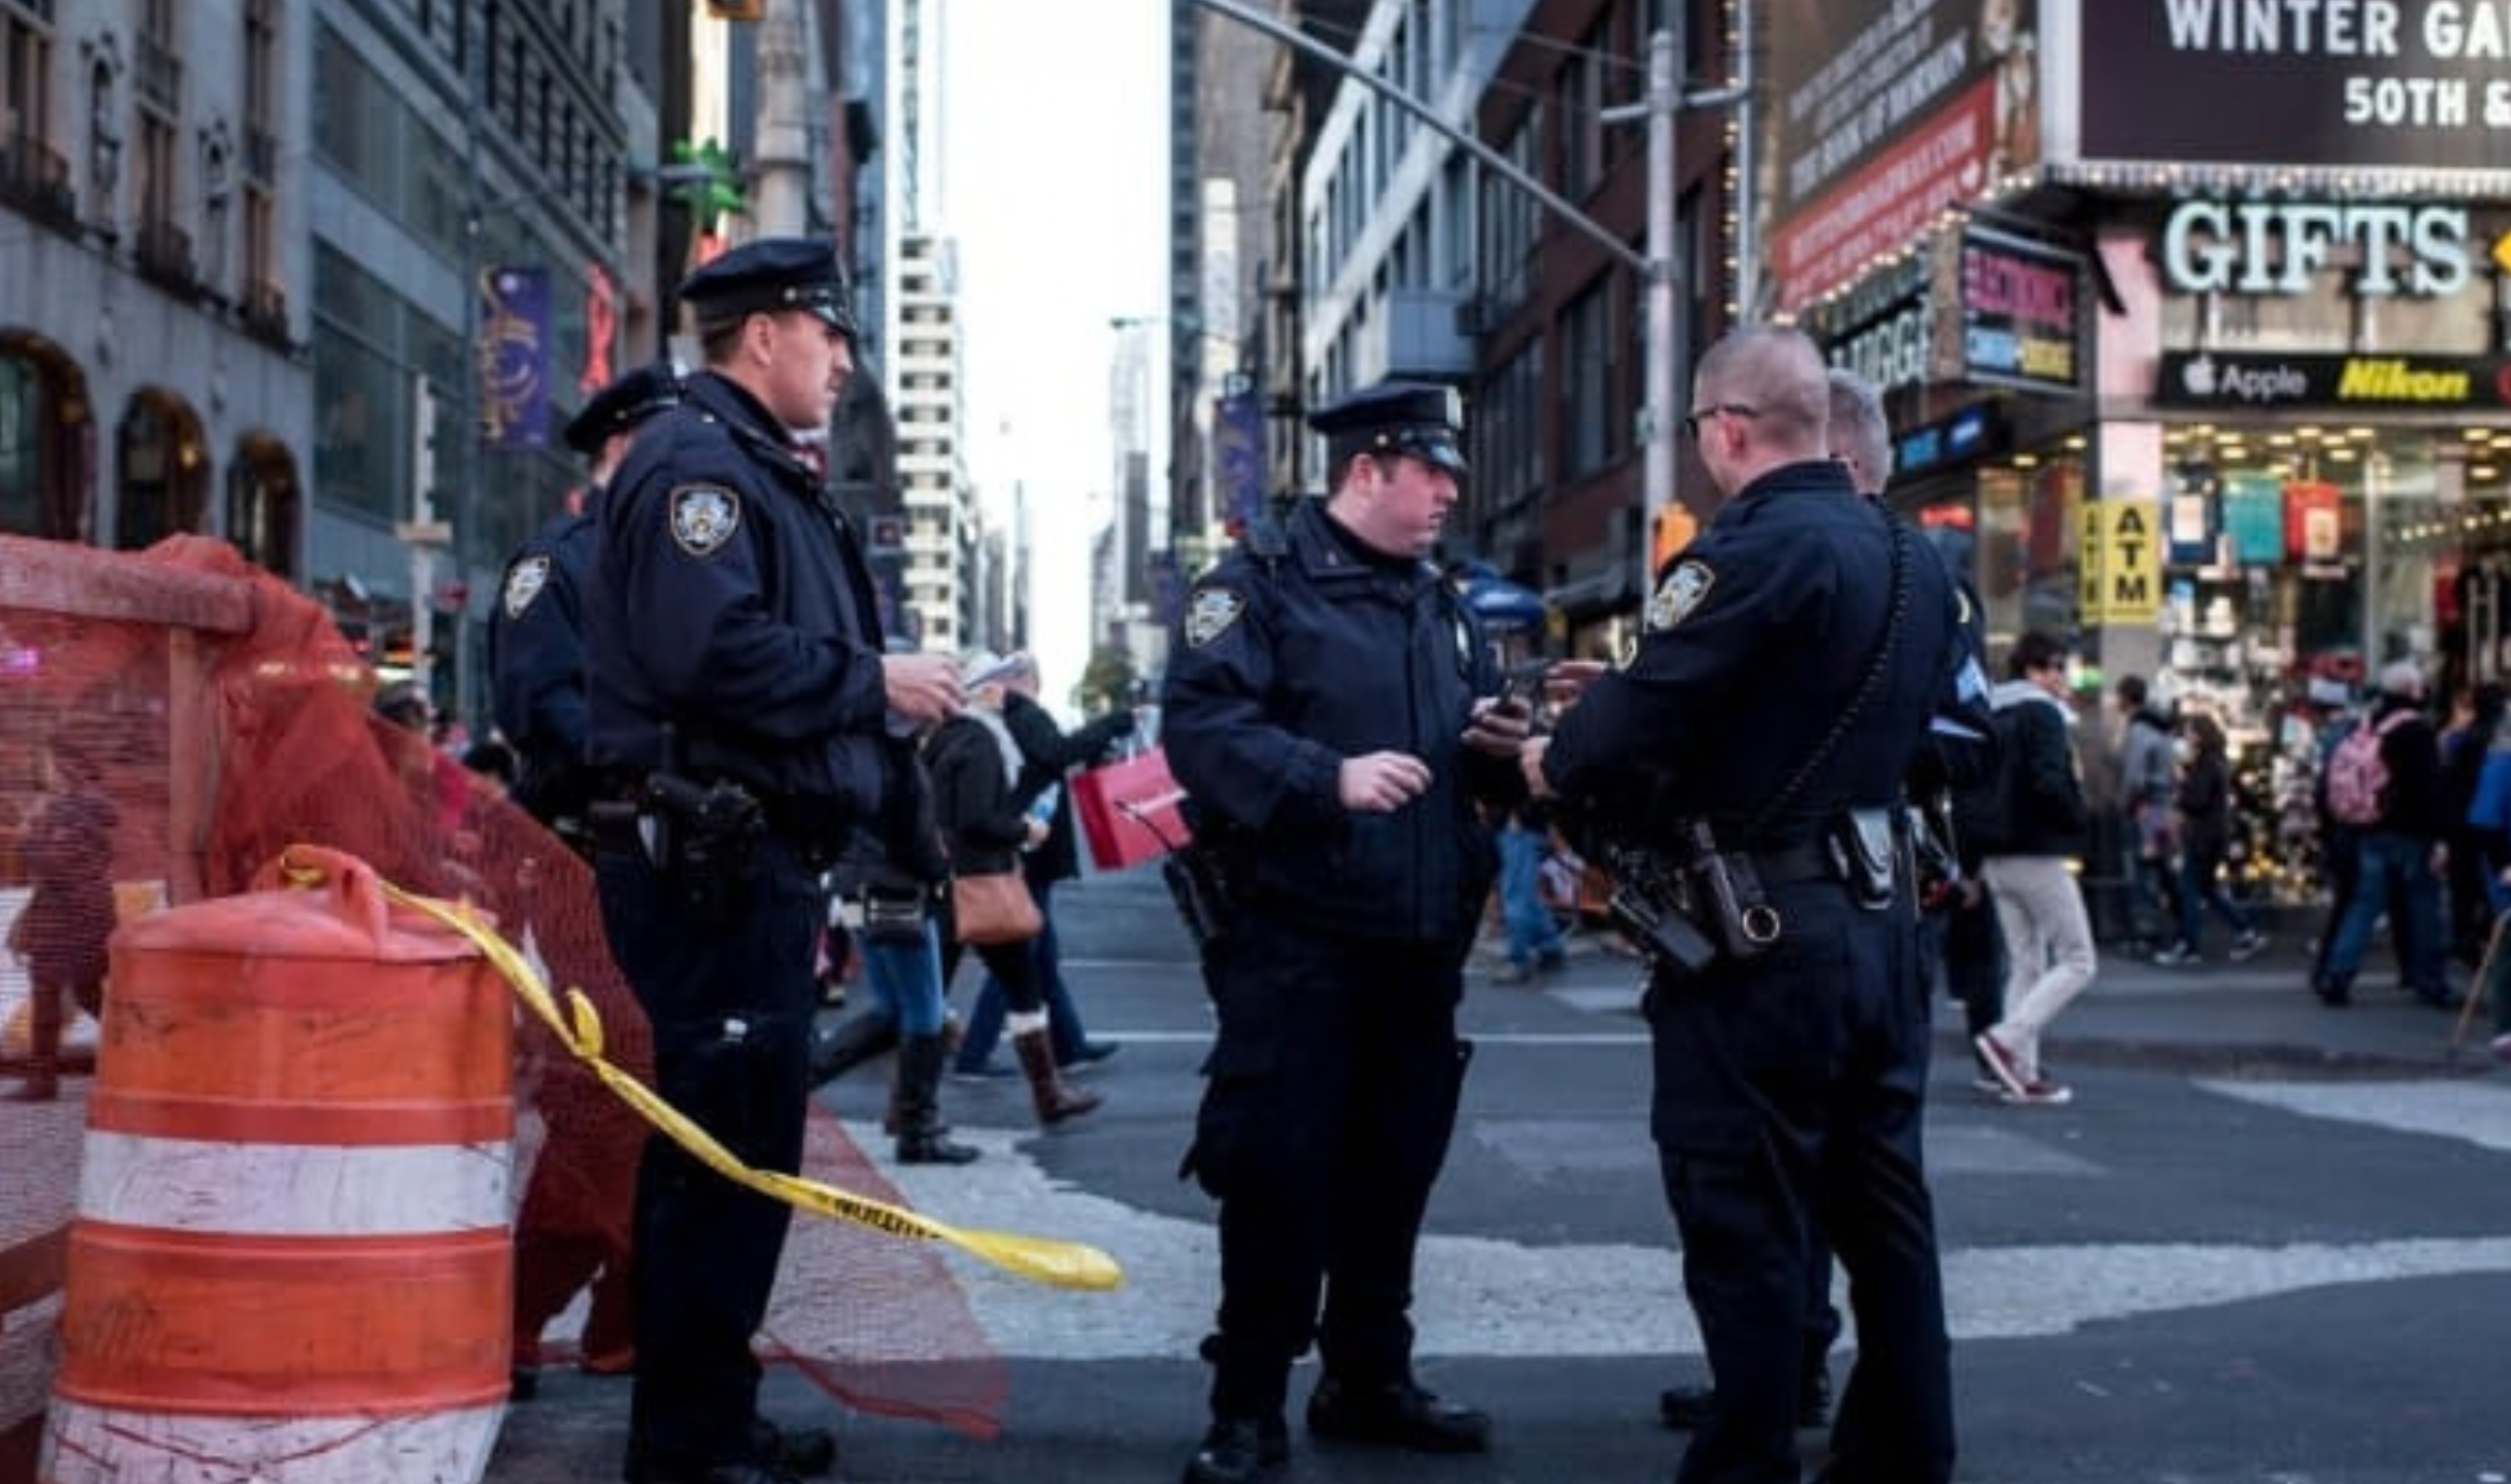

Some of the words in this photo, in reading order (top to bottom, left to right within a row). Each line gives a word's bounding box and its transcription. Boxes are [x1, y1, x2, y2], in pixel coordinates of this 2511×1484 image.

[2167, 0, 2400, 56] WINTER
[2422, 1, 2511, 58] GA
[2343, 77, 2467, 126] 50TH
[2164, 202, 2470, 295] GIFTS
[2221, 363, 2307, 398] Apple
[2338, 358, 2471, 400] Nikon
[2115, 506, 2146, 603] ATM
[834, 1198, 943, 1240] AUTION
